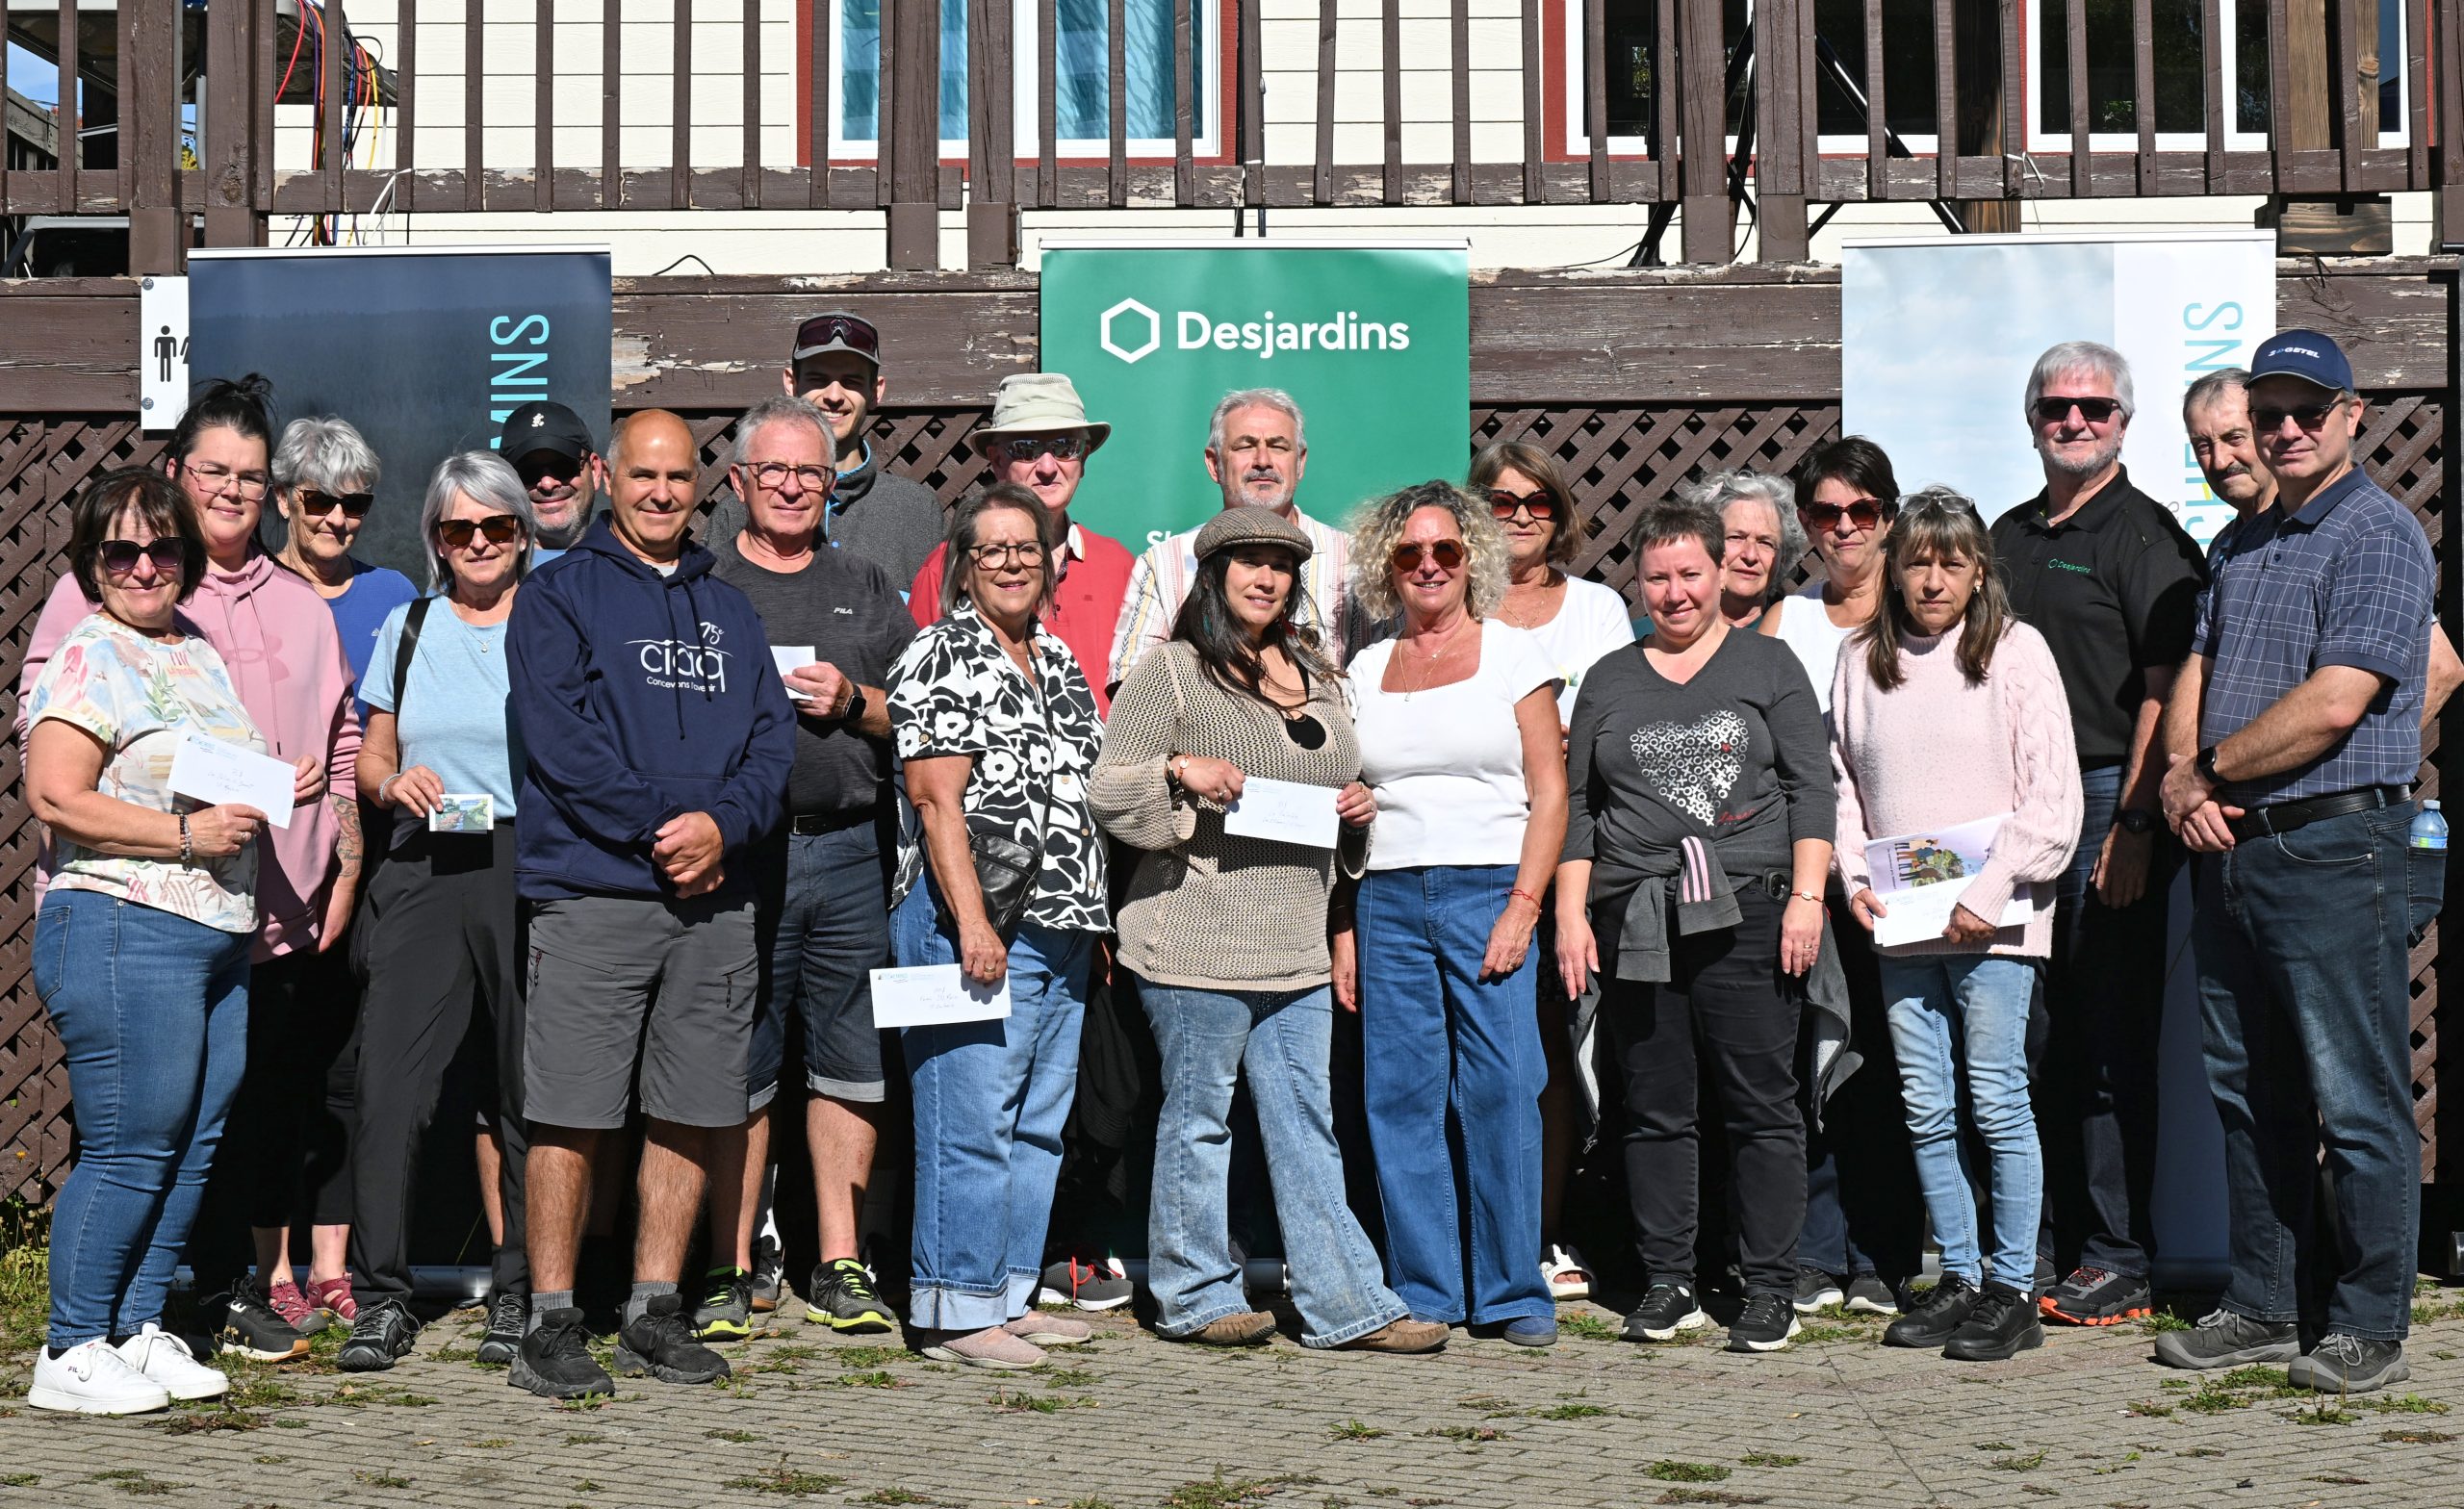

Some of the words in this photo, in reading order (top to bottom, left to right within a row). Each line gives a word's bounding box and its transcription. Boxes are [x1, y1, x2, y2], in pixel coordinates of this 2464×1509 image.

[1177, 310, 1410, 359] Desjardins
[2057, 560, 2092, 574] Desjardins
[833, 606, 854, 615] FILA
